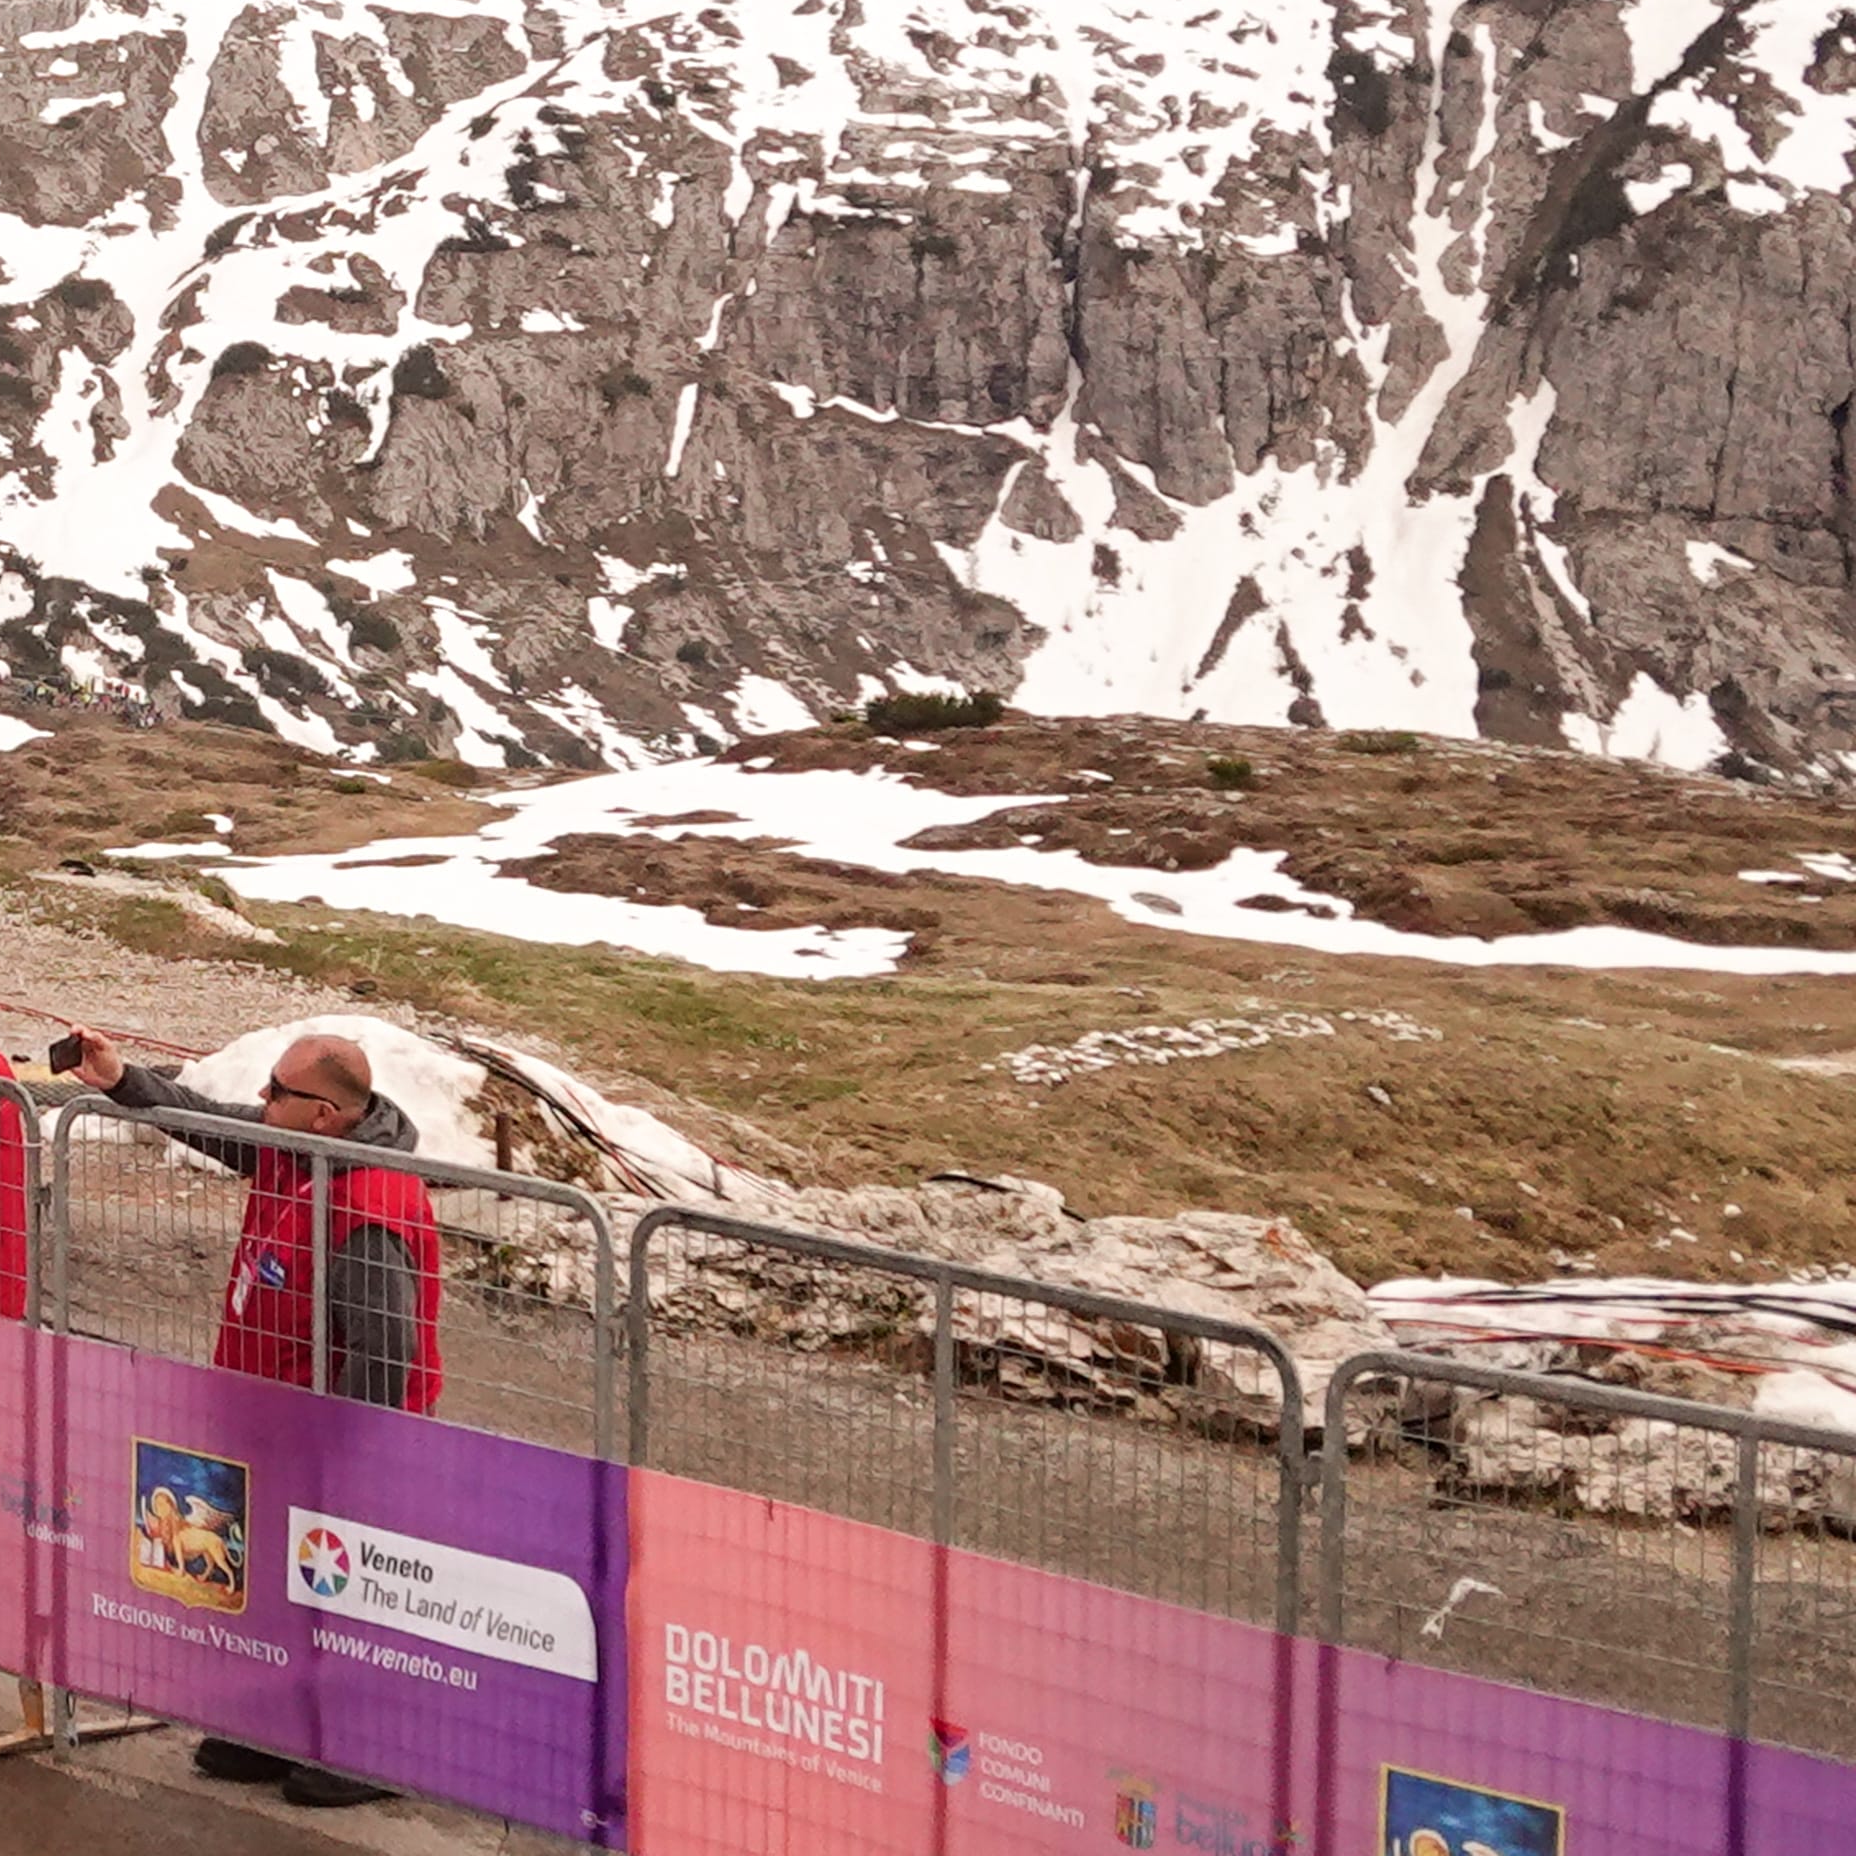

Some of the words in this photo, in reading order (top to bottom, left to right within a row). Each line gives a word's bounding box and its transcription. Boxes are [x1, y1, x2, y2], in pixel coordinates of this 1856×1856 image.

[360, 1541, 434, 1584] Veneto
[91, 1593, 177, 1637] REGIONE
[207, 1624, 289, 1667] VENETO
[360, 1576, 399, 1610] The
[405, 1588, 455, 1626] Land
[459, 1606, 485, 1633] of
[486, 1609, 556, 1654] Venice
[312, 1627, 478, 1691] www.veneto.eu
[665, 1665, 884, 1765] BELLUNESI
[666, 1711, 700, 1740] The
[703, 1724, 797, 1767] Mountains
[801, 1752, 822, 1774] of
[824, 1757, 884, 1794] Venice
[979, 1731, 1044, 1766] FONDO
[980, 1756, 1052, 1794] COMUNI
[980, 1782, 1086, 1830] CONFINANTI
